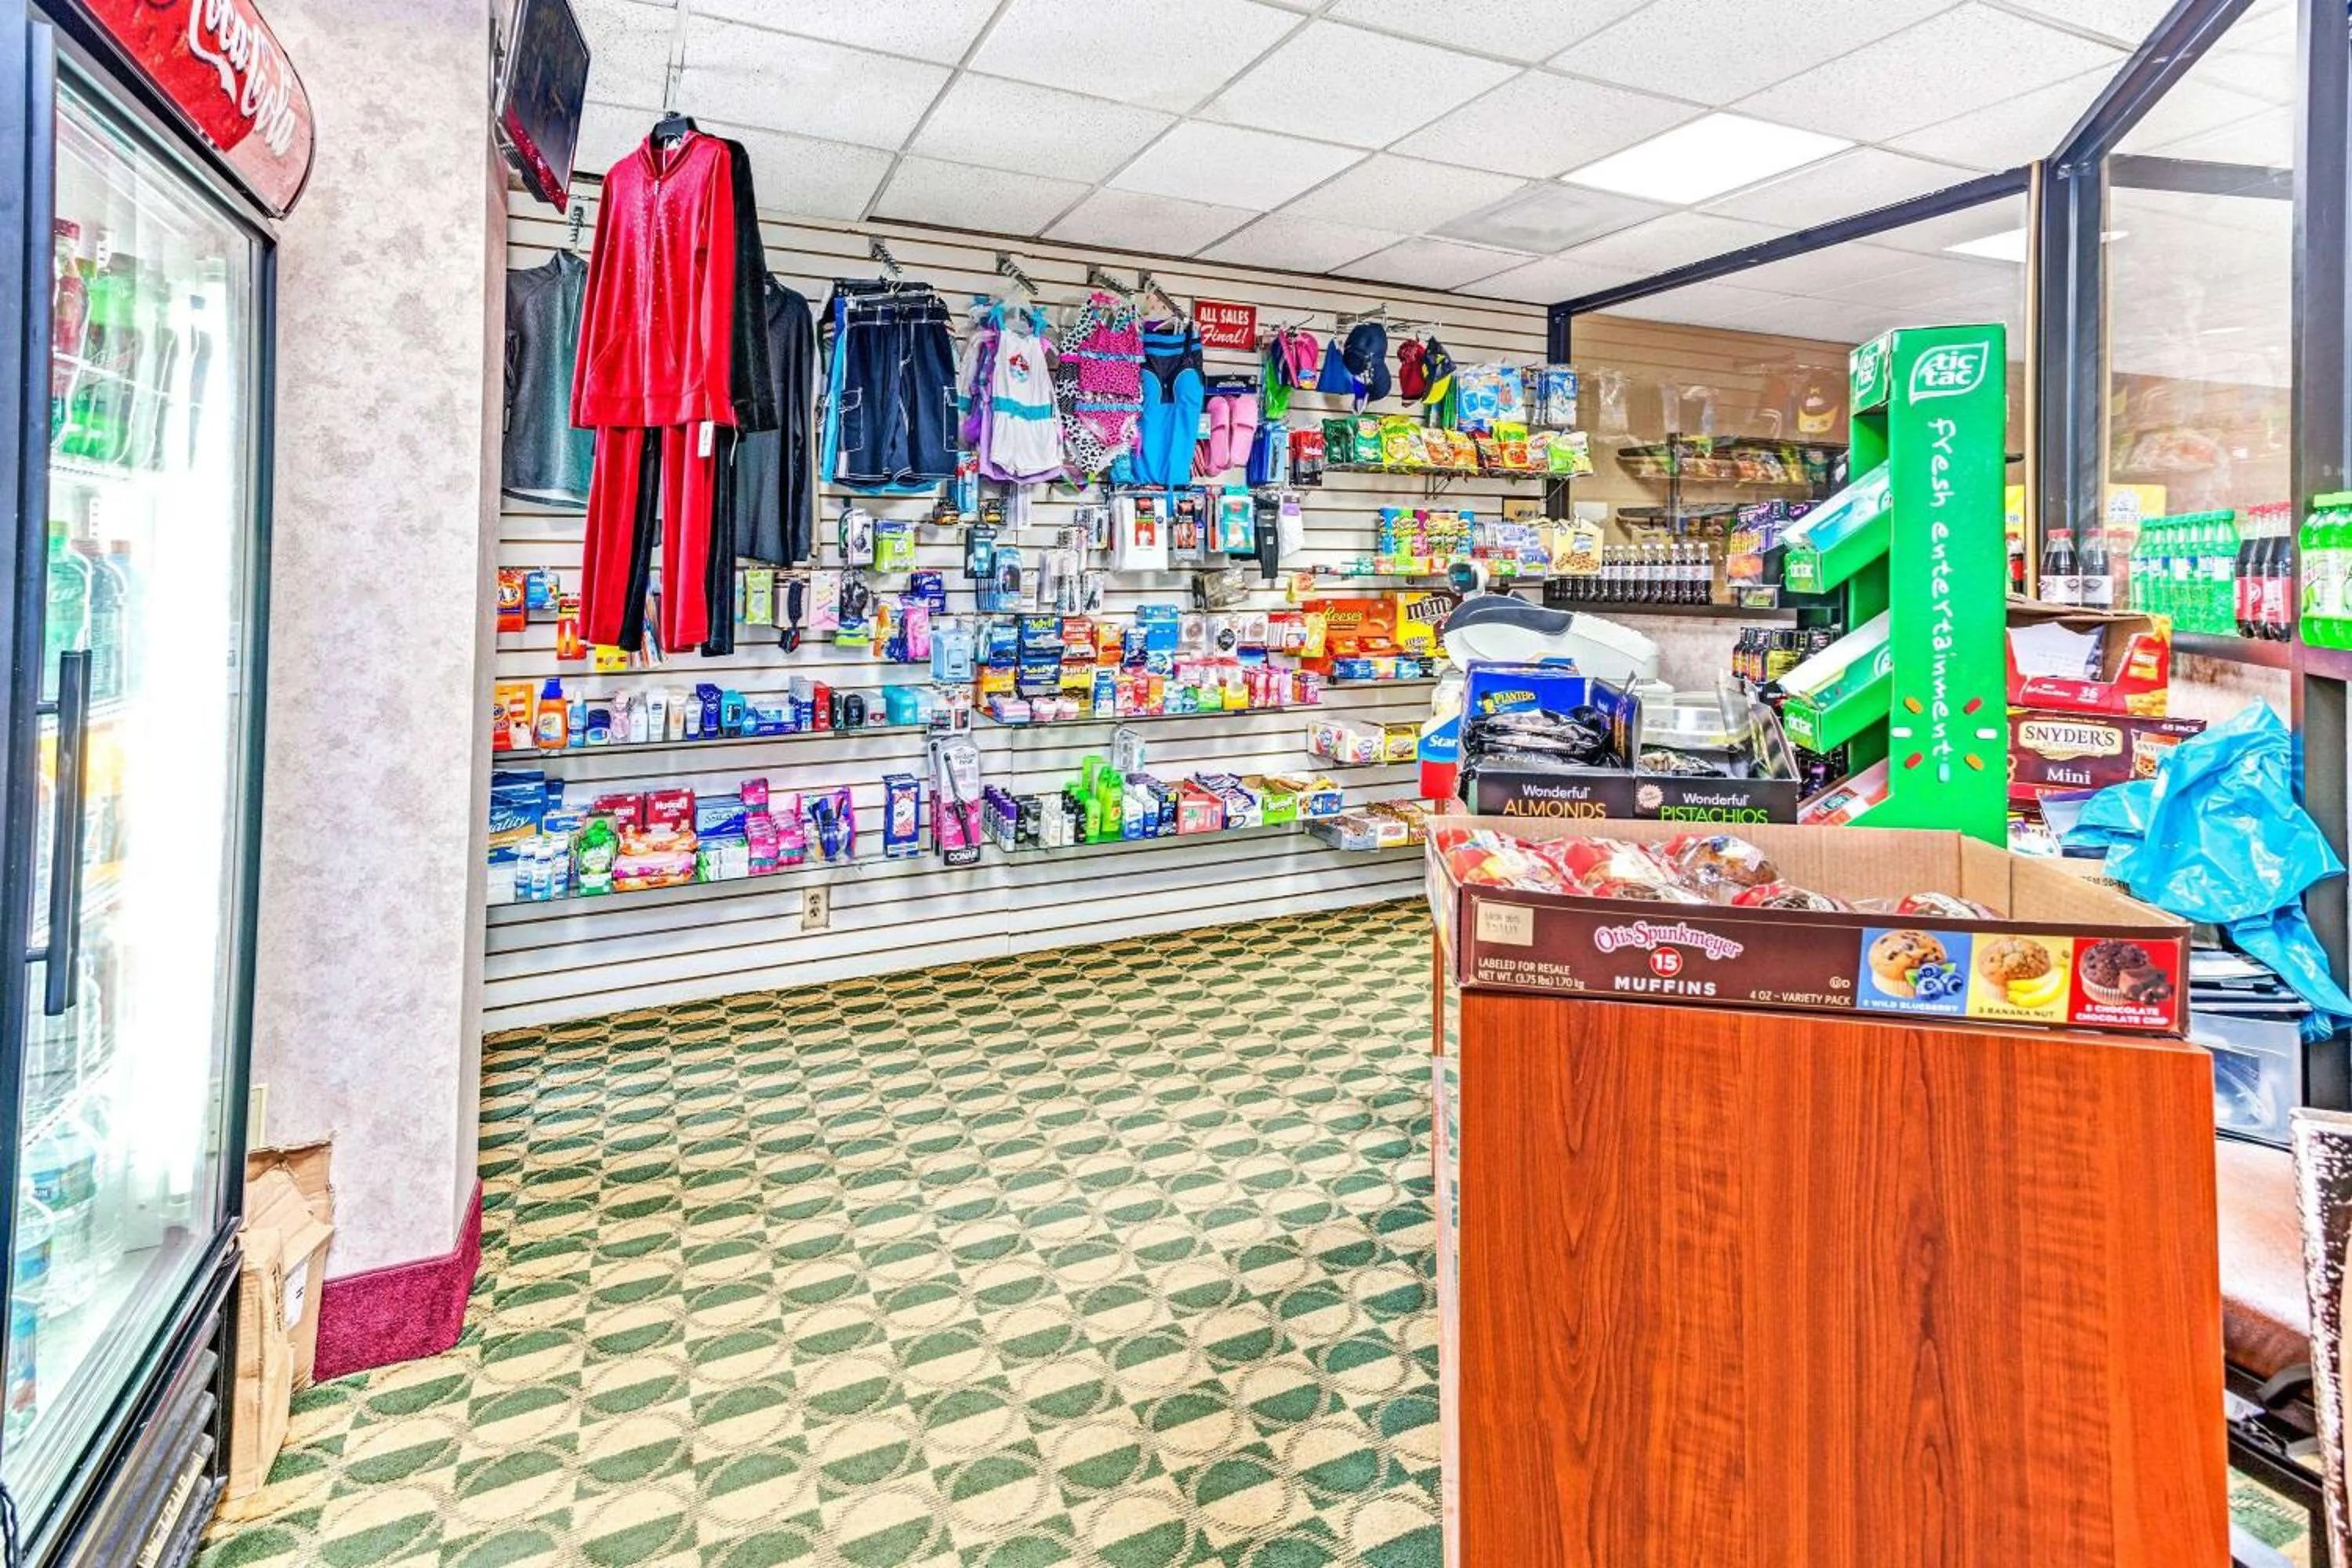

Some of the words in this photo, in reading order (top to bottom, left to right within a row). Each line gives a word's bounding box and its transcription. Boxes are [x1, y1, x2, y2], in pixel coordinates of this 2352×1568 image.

[1200, 307, 1218, 322] ALL
[1221, 308, 1249, 325] SALES
[1200, 324, 1249, 344] Final!
[1932, 351, 1979, 371] tic
[1924, 368, 1973, 387] tac
[1927, 418, 1957, 507] fresh
[2025, 725, 2116, 747] SNYDER'S
[2046, 768, 2092, 784] Mini
[1523, 784, 1588, 799] Wonderful
[1682, 793, 1748, 807] Wonderful
[1503, 798, 1606, 819] ALMONDS
[1661, 806, 1768, 824] PISTACHIOS
[488, 815, 531, 833] uality
[1595, 926, 1633, 953] Otis
[1633, 920, 1744, 960] Spunkmeyer
[1478, 956, 1516, 971] LABELED
[1518, 960, 1536, 973] FOR
[1537, 963, 1571, 975] RESALE
[1654, 953, 1678, 971] 15
[1478, 970, 1495, 981] NET
[1614, 976, 1717, 996] MUFFINS
[1749, 990, 1756, 1000] 4
[1759, 991, 1772, 1001] OZ
[1782, 993, 1823, 1005] VARIETY
[1824, 995, 1852, 1006] PACK
[1988, 1007, 2031, 1017] BANANA
[2033, 1010, 2056, 1018] NUT
[2075, 1013, 2140, 1025] CHOCOLATE
[2094, 1005, 2159, 1017] CHOCOLATE
